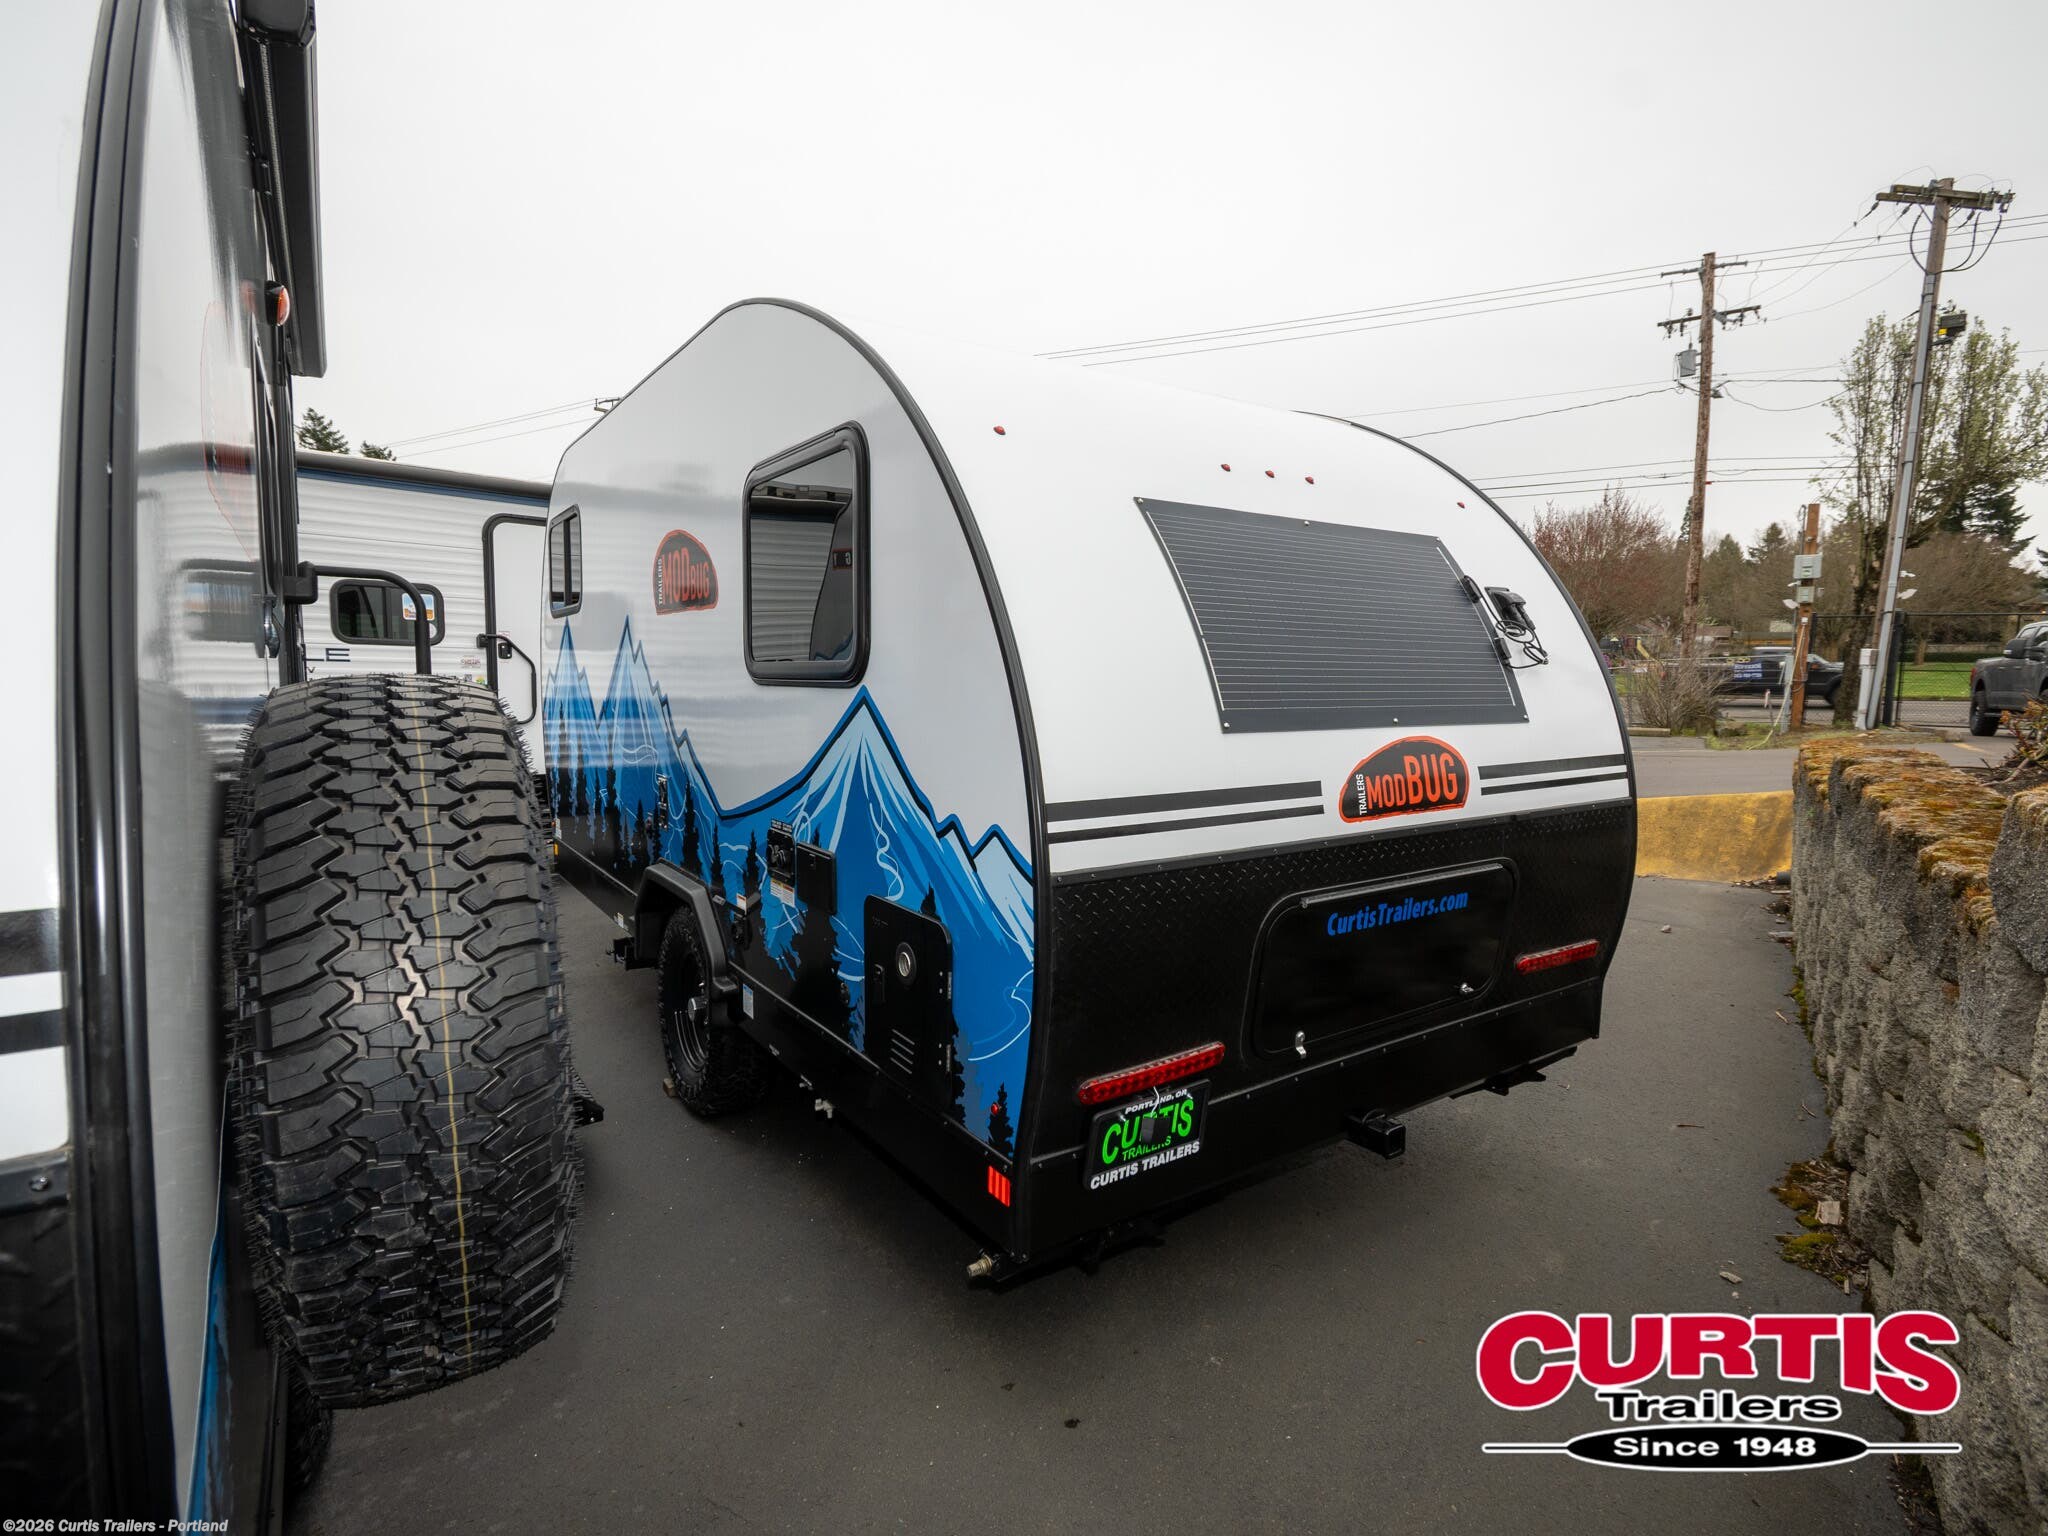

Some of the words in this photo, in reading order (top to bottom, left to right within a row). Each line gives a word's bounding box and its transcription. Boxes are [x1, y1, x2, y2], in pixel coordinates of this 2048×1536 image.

[1355, 773, 1368, 815] TRAILERS
[1327, 892, 1469, 936] CurtisTrailers.com
[1090, 1163, 1138, 1189] CURTIS
[1142, 1141, 1200, 1171] TRAILERS
